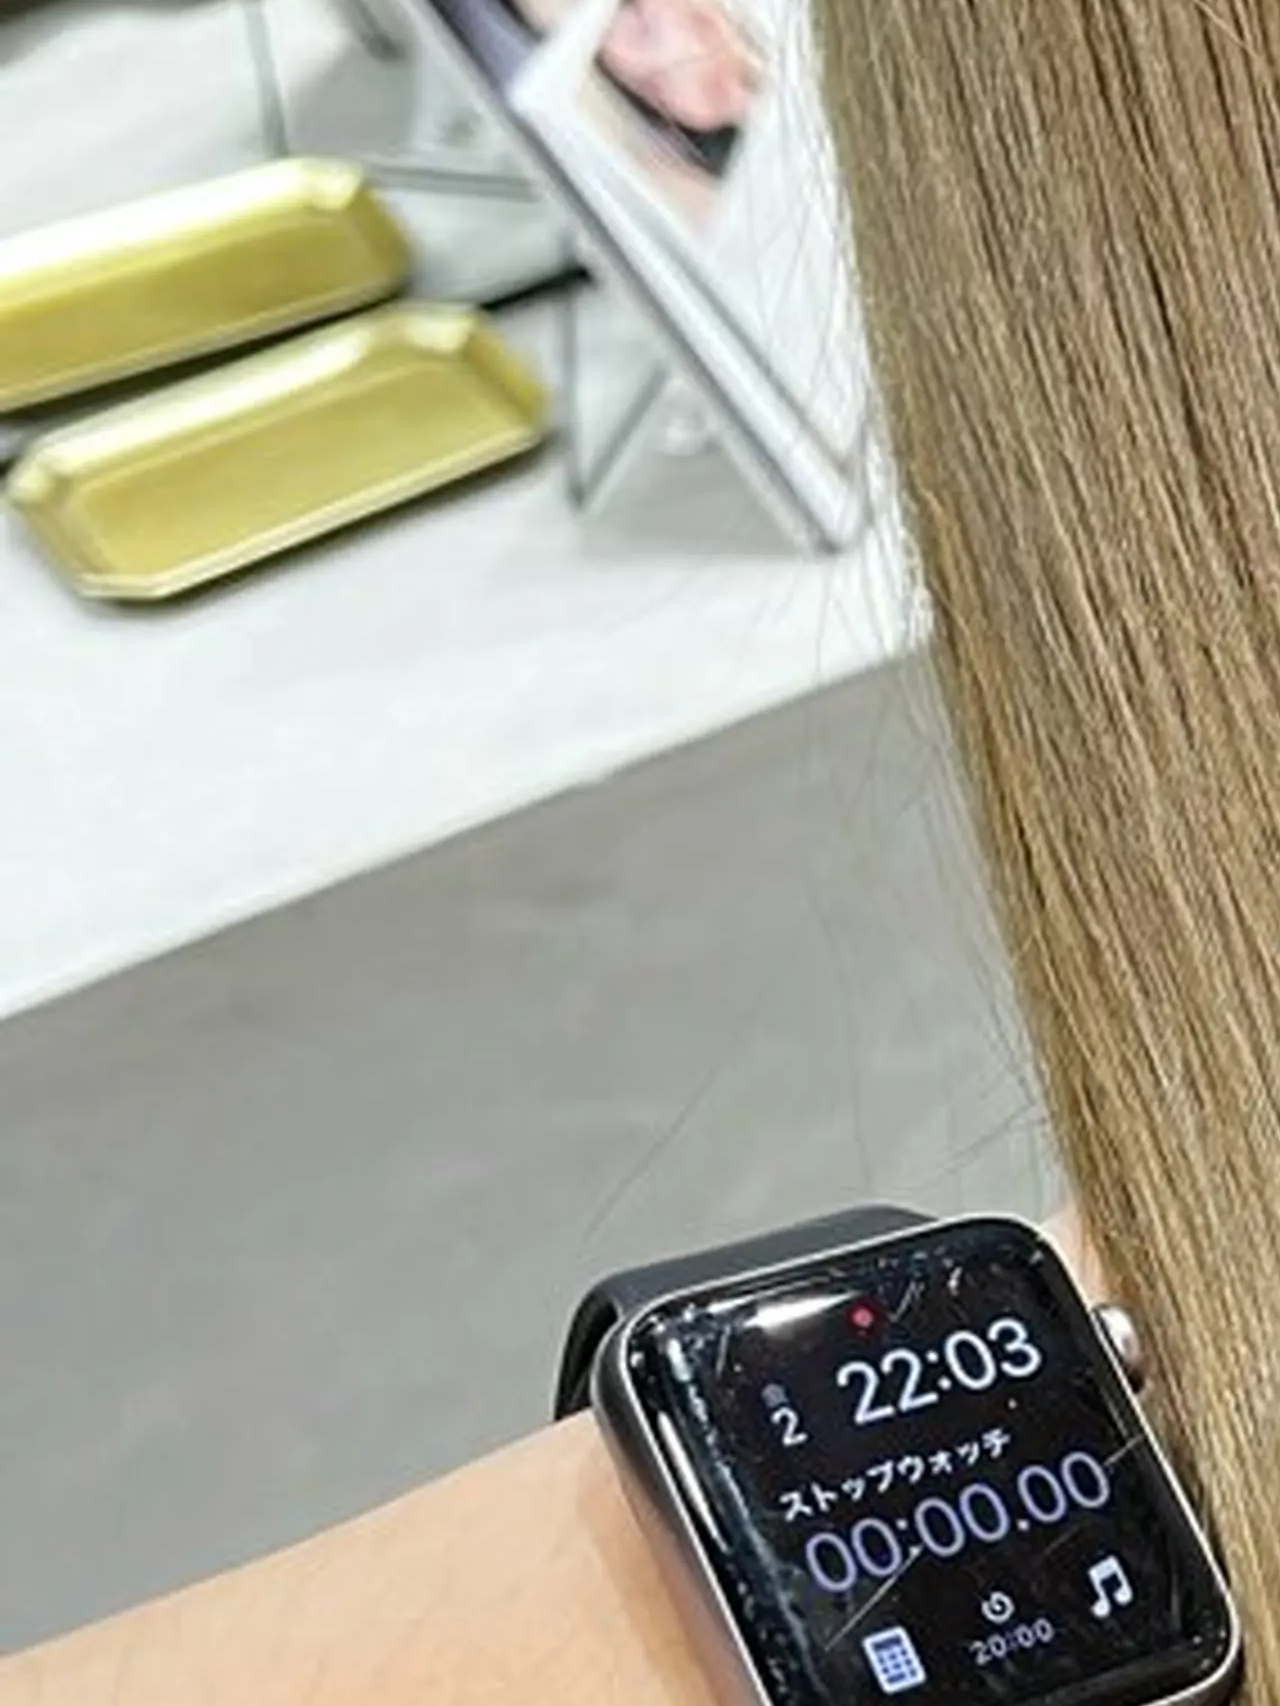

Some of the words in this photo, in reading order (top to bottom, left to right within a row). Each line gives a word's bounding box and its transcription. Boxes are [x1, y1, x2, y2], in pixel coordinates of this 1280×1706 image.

[836, 1317, 1042, 1425] 22:03
[770, 1406, 809, 1448] 2
[780, 1428, 1010, 1521] ストップウォッチ
[805, 1451, 1110, 1592] 00:00.00
[969, 1617, 1054, 1666] 20:00
